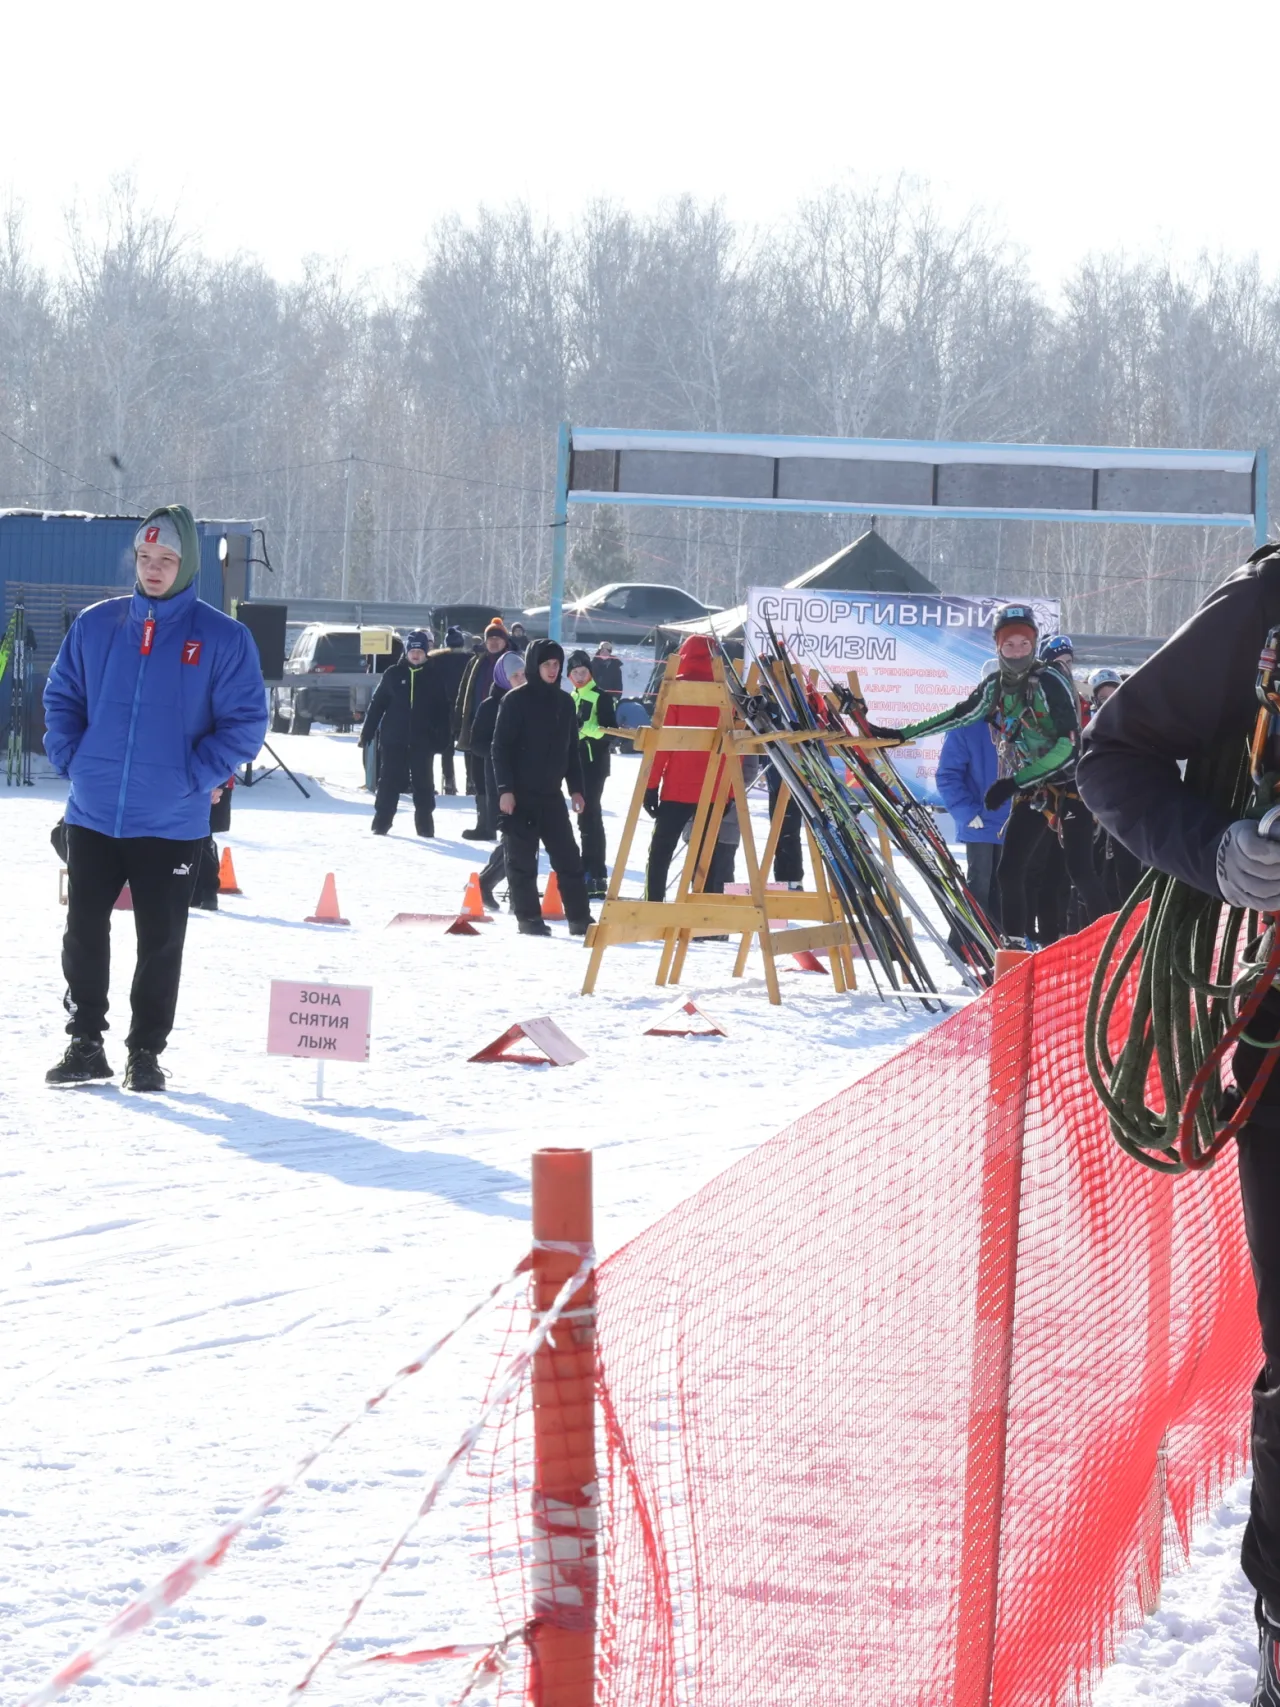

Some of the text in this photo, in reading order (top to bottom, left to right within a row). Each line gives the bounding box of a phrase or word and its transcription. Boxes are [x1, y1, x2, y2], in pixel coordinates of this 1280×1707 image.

[757, 596, 998, 628] СПОРТИВНЫЙ
[755, 632, 896, 660] ТУРИЗМ
[864, 684, 902, 693] АЗАРТ
[901, 828, 943, 879] FISCHER
[300, 990, 342, 1006] ЗОНА
[288, 1012, 349, 1029] СНЯТИЯ
[297, 1035, 338, 1050] ЛЫЖ
